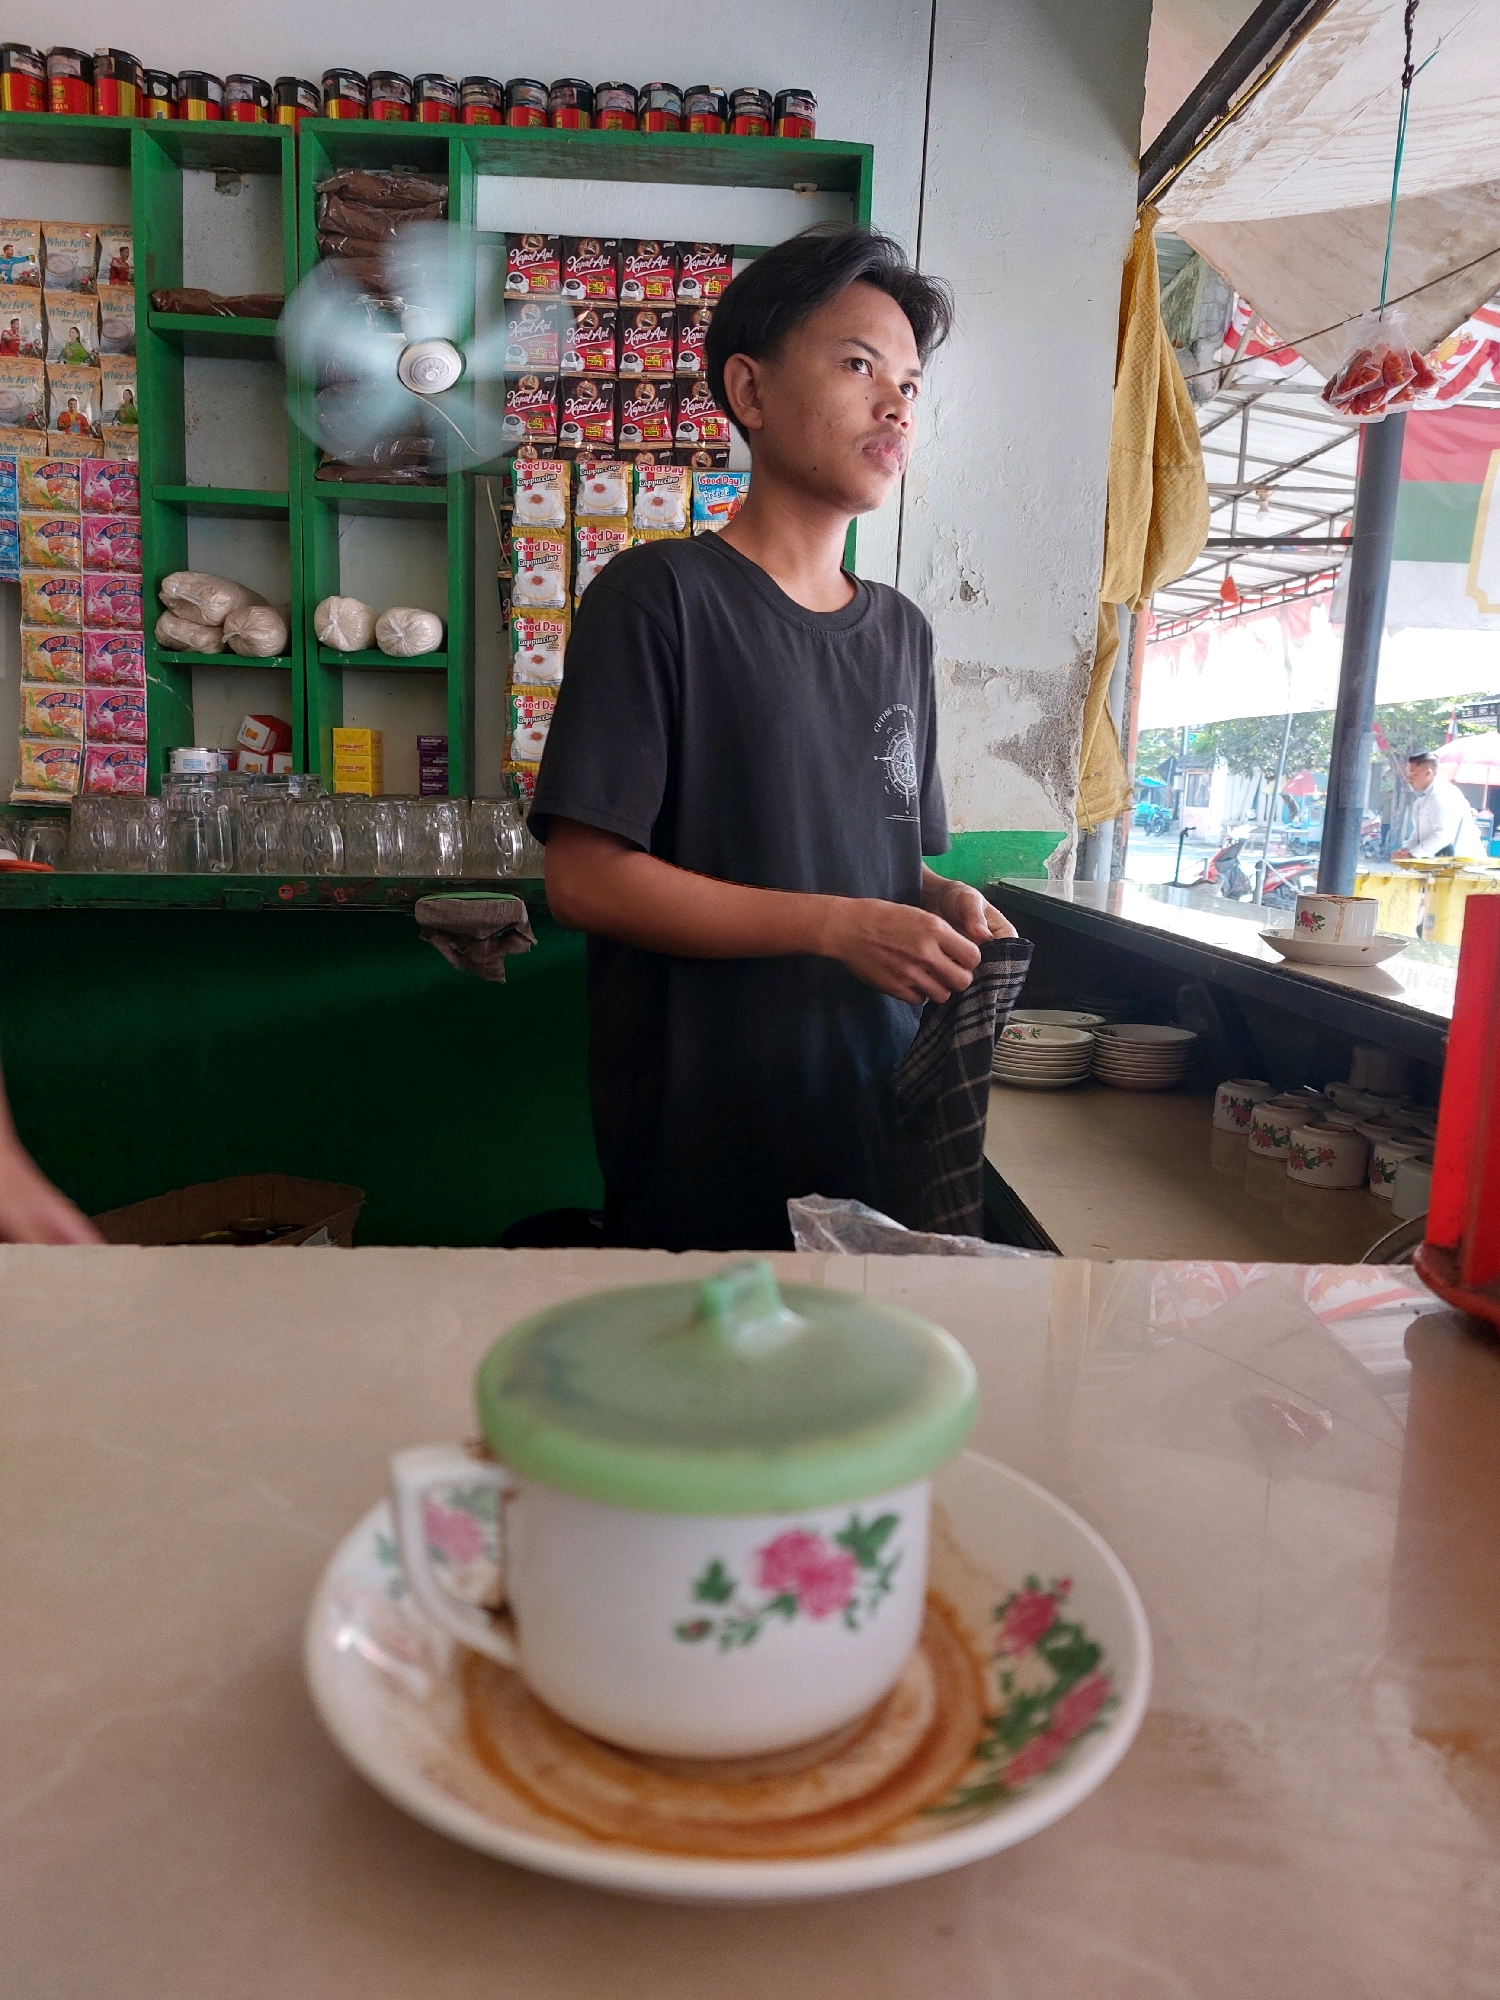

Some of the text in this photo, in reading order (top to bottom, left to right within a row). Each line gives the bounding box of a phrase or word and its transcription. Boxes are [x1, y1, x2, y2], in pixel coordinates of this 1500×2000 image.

[510, 247, 555, 266] Kapal Api
[566, 255, 594, 273] Kapal
[593, 254, 611, 269] Api
[684, 253, 727, 272] Kapal Api
[625, 254, 670, 274] Kapal Api
[509, 319, 552, 338] Kapal Api
[566, 326, 610, 345] Kapal Api
[682, 326, 705, 345] Kapa
[625, 326, 668, 346] Kapal Api
[507, 389, 550, 408] Kapal Api
[565, 397, 609, 416] Kapal Api
[624, 397, 667, 418] Kapal Api
[681, 397, 707, 415] Kapal
[0, 461, 14, 472] CE
[513, 460, 563, 474] Good Day
[580, 465, 620, 476] Cappuccino
[636, 464, 685, 476] Good Day
[517, 473, 557, 487] Cappuccino
[639, 476, 679, 488] Cappuccino
[699, 475, 740, 487] Good Day
[577, 530, 626, 544] Good Day
[514, 540, 564, 555] Good Day
[581, 544, 620, 557] Cappuccino
[518, 554, 558, 567] Cappuccino
[515, 620, 563, 635] Good Day
[518, 635, 558, 647] Cappuccino
[514, 698, 556, 711] Good Da
[517, 713, 553, 724] Cappuccin
[514, 775, 536, 783] Goo
